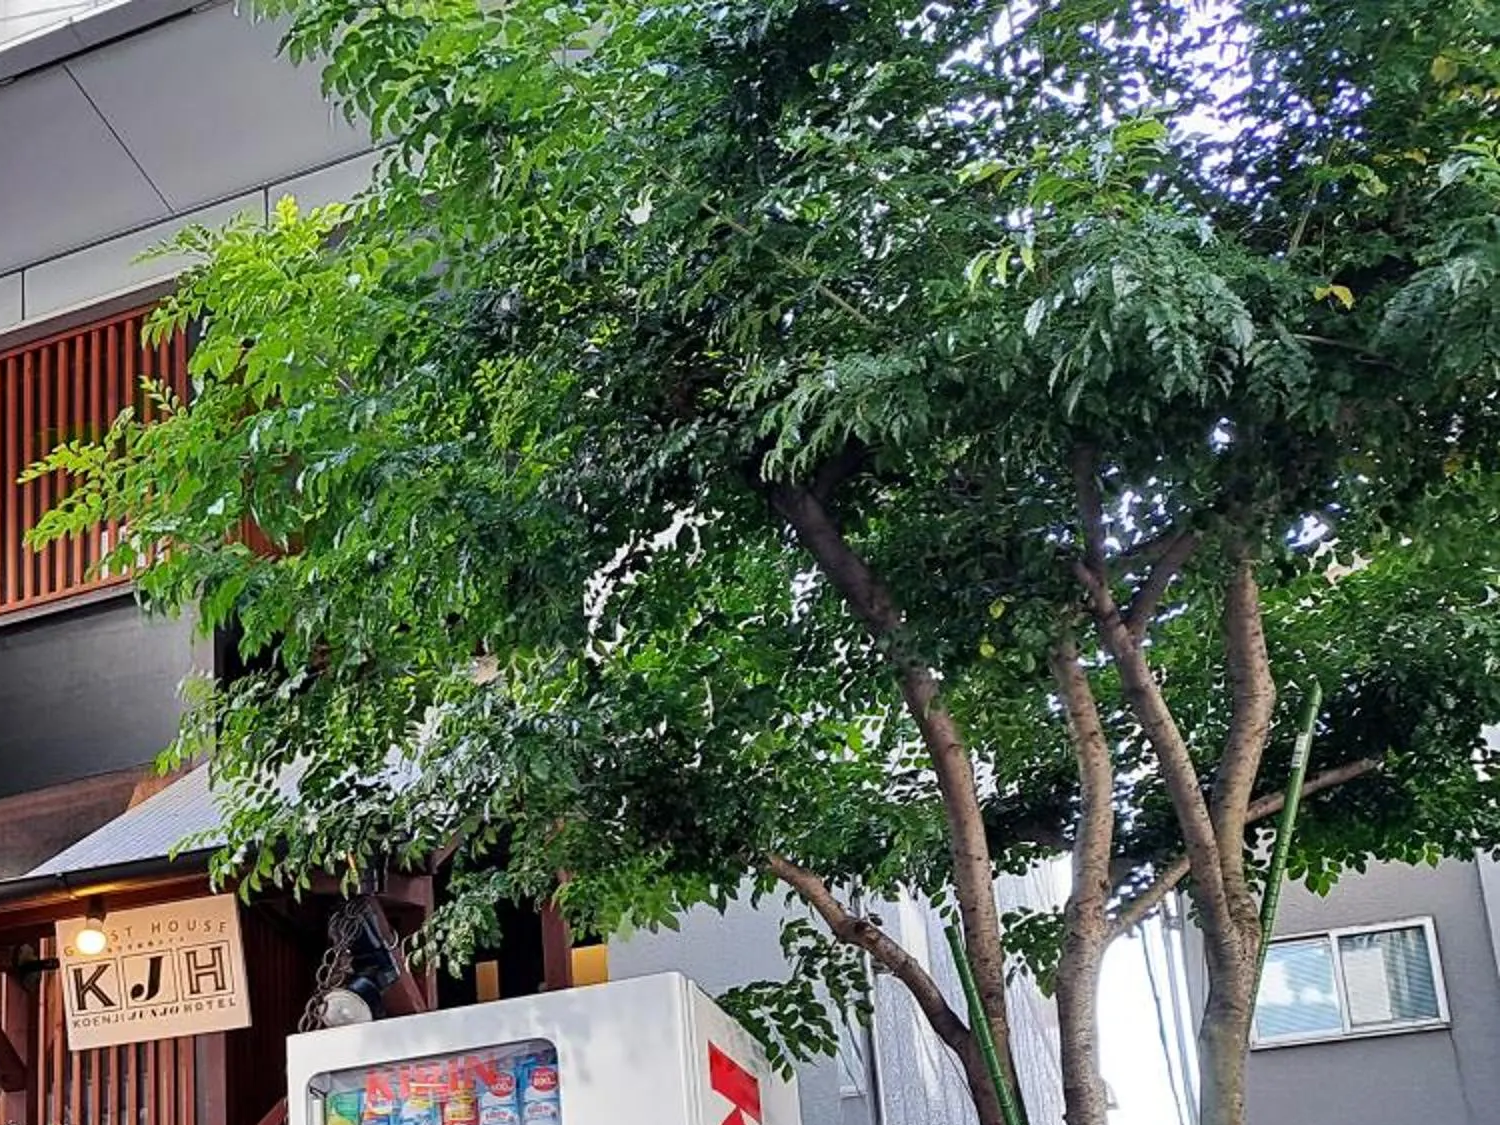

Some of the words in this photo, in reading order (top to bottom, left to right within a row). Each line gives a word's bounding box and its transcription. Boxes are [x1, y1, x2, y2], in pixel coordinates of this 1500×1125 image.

[151, 919, 229, 934] HOUSE
[72, 1014, 126, 1029] KOENJI
[127, 1006, 180, 1022] JUNJO
[183, 999, 237, 1013] HOTEL
